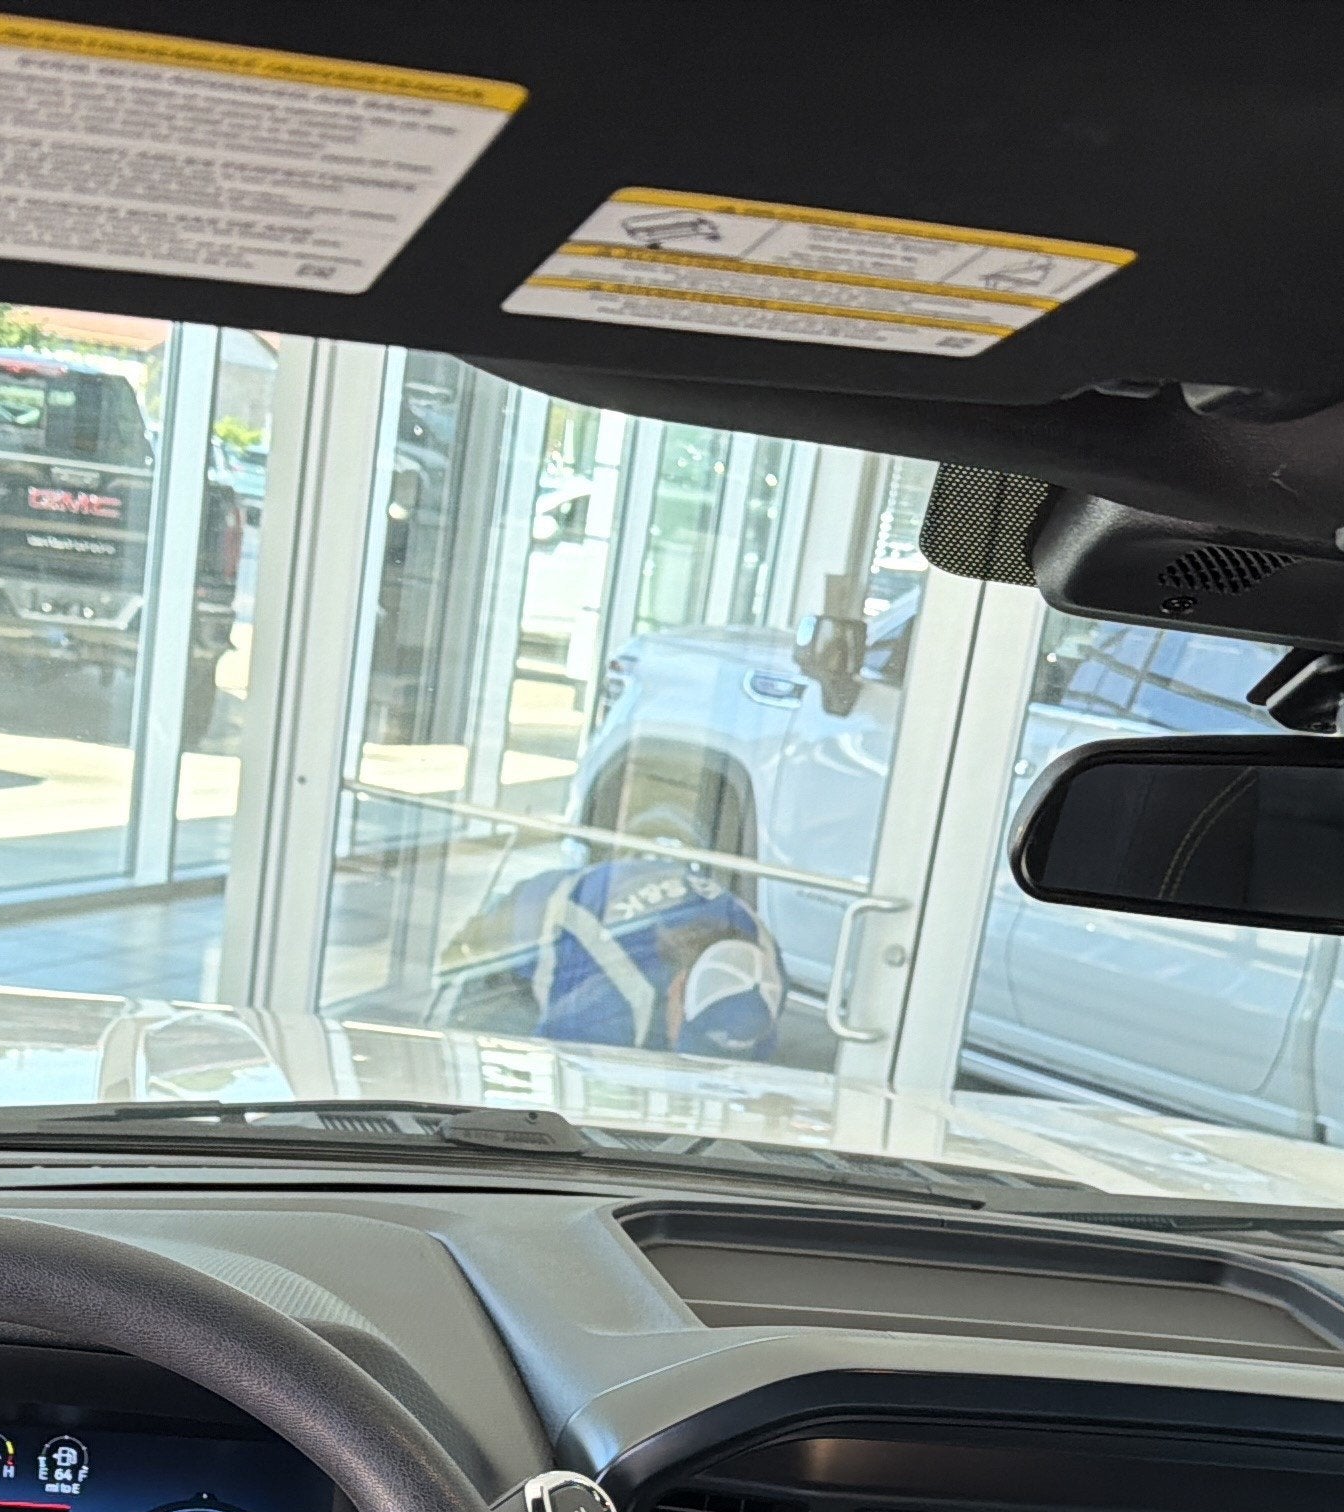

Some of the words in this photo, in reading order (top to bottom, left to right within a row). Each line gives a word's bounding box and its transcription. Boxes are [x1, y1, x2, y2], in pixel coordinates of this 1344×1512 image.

[27, 486, 122, 519] GMC
[3, 1465, 15, 1478] H
[38, 1468, 48, 1480] E
[54, 1468, 73, 1482] 64
[78, 1470, 89, 1482] F
